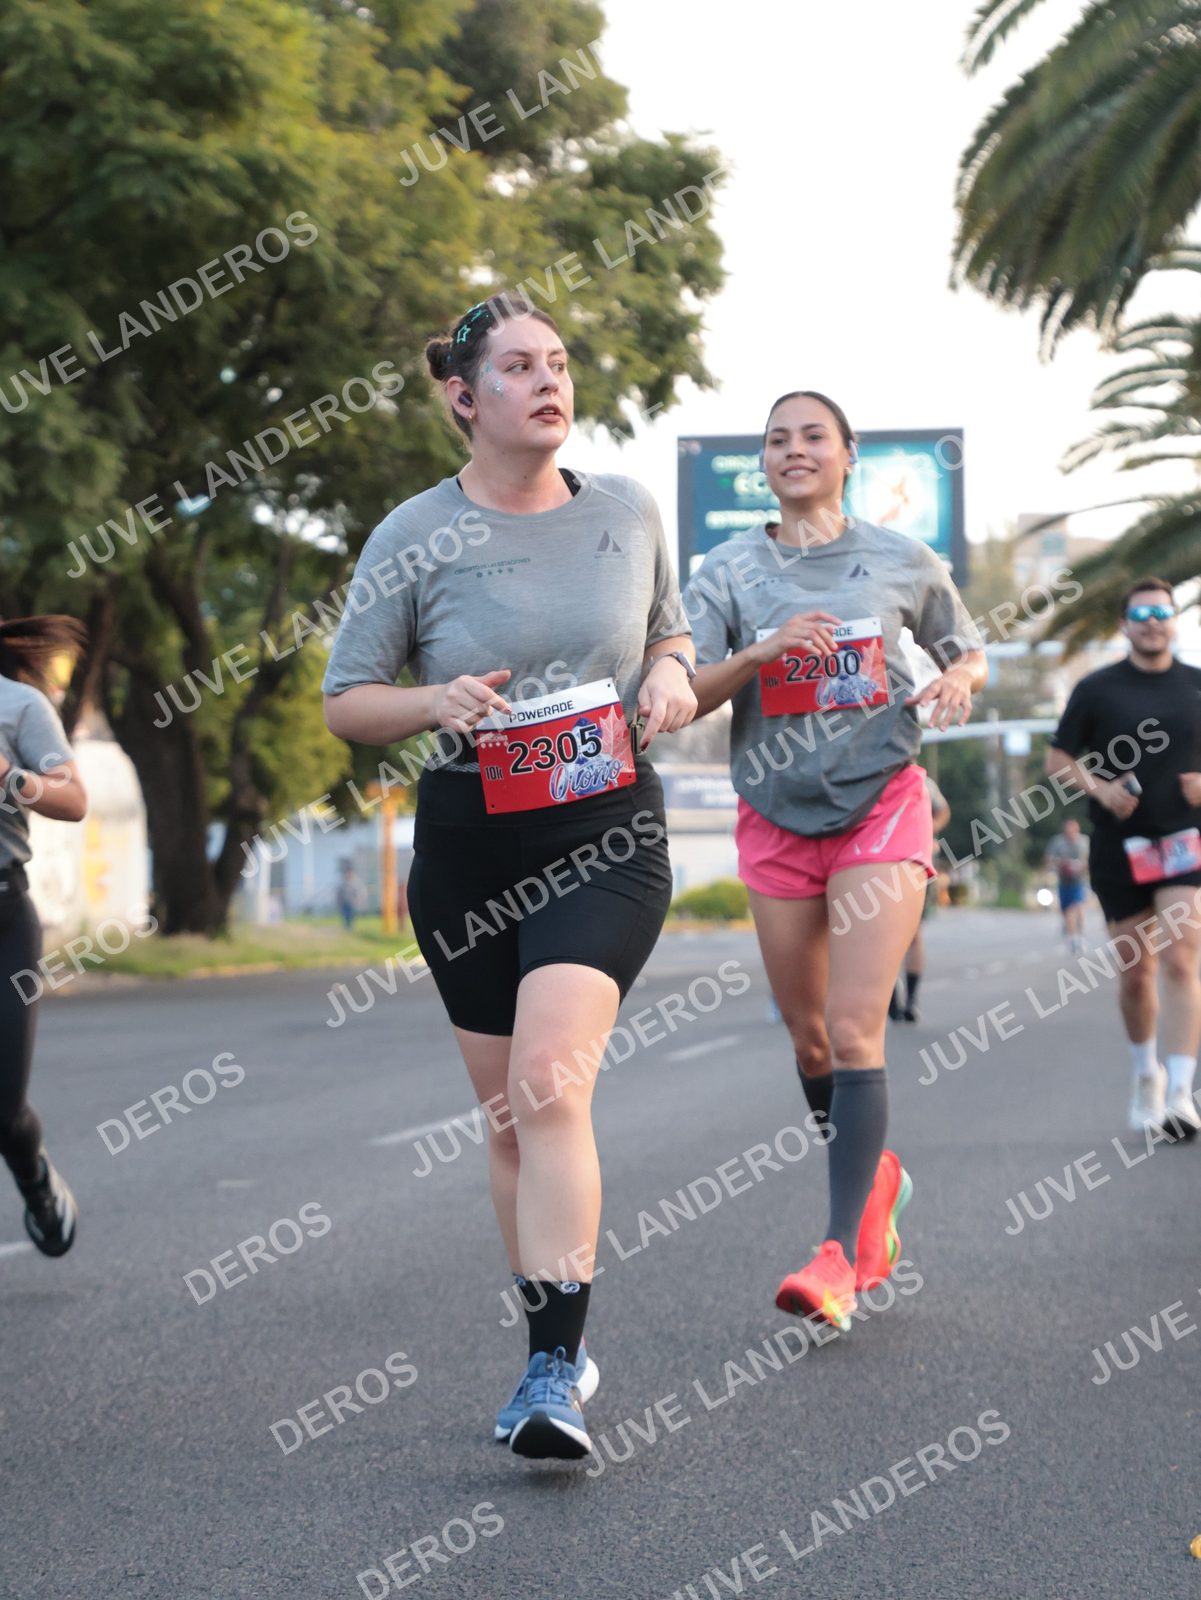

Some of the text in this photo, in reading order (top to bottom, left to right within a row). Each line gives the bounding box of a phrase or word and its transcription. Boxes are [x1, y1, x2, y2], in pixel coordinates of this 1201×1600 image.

[785, 650, 860, 682] 2200
[509, 700, 574, 723] POWERADE
[506, 723, 602, 776] 2305
